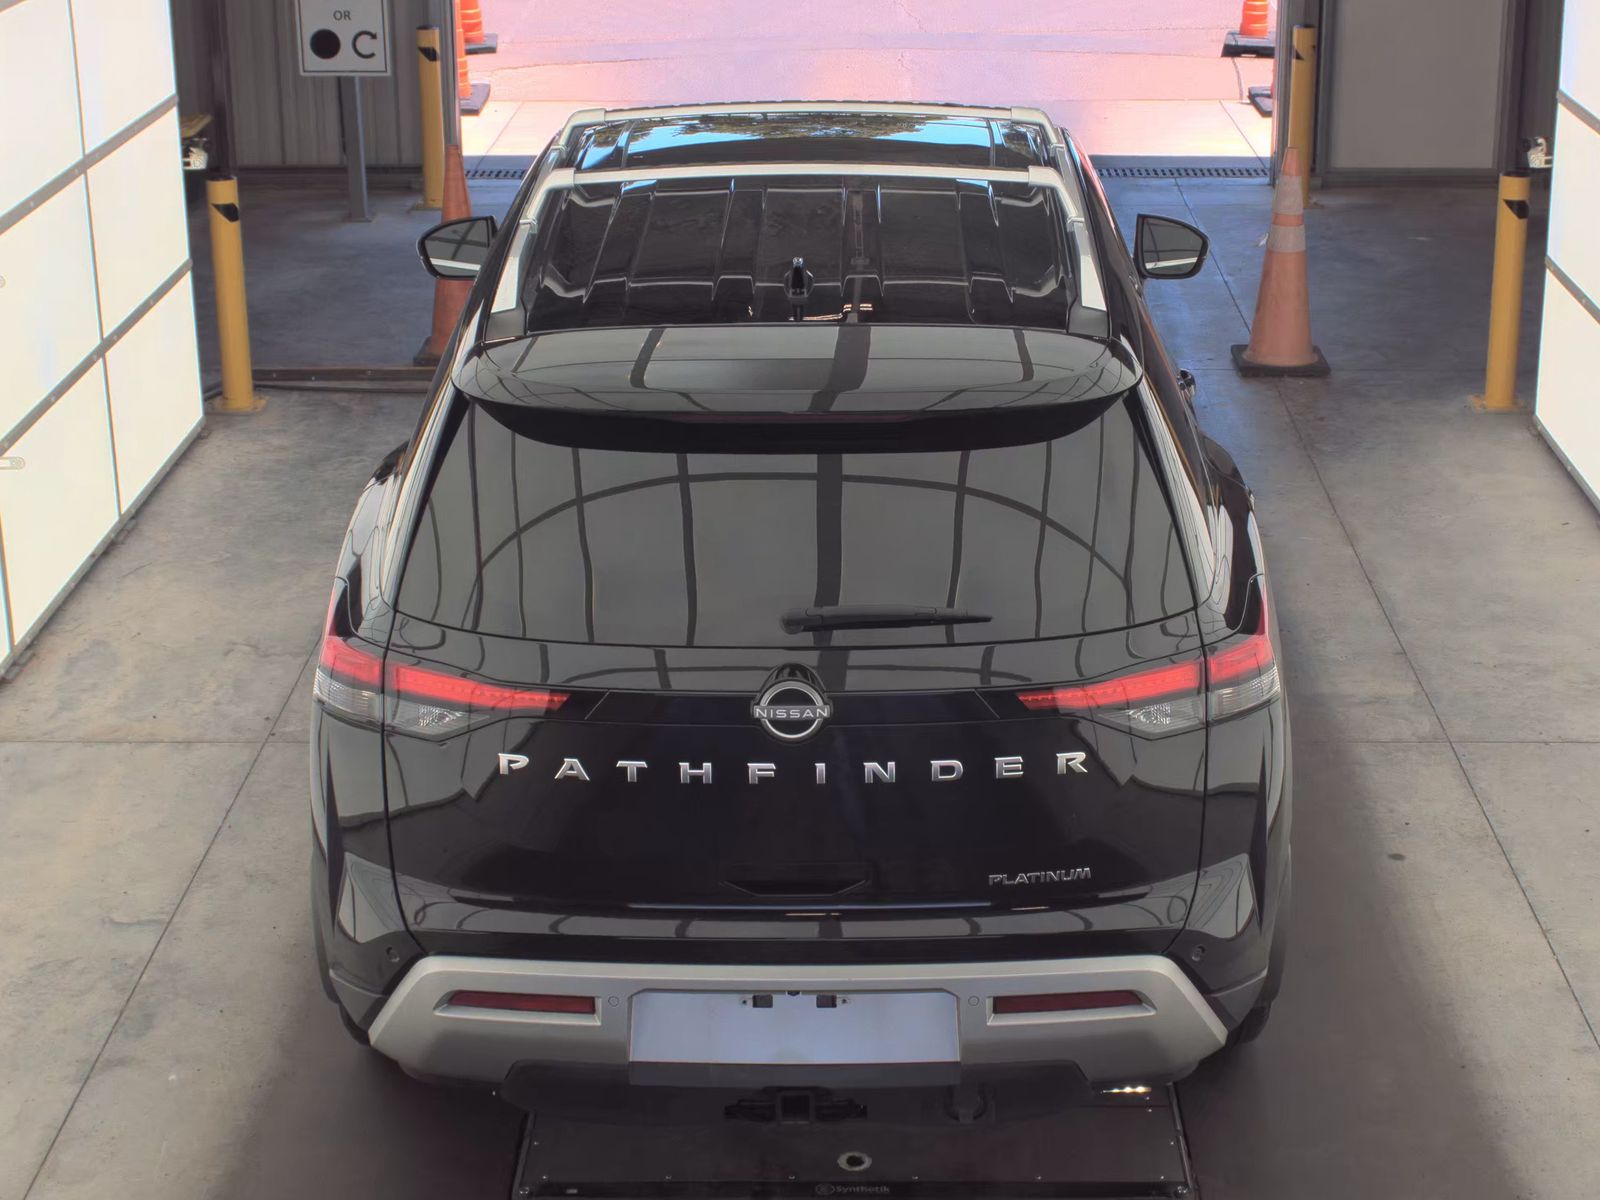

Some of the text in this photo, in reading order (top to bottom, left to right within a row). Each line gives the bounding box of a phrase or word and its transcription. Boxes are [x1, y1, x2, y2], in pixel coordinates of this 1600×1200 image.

[333, 10, 351, 21] OR
[755, 707, 828, 719] NISSAN
[498, 751, 1088, 784] PATHFINDER
[988, 867, 1091, 886] PLATINUM
